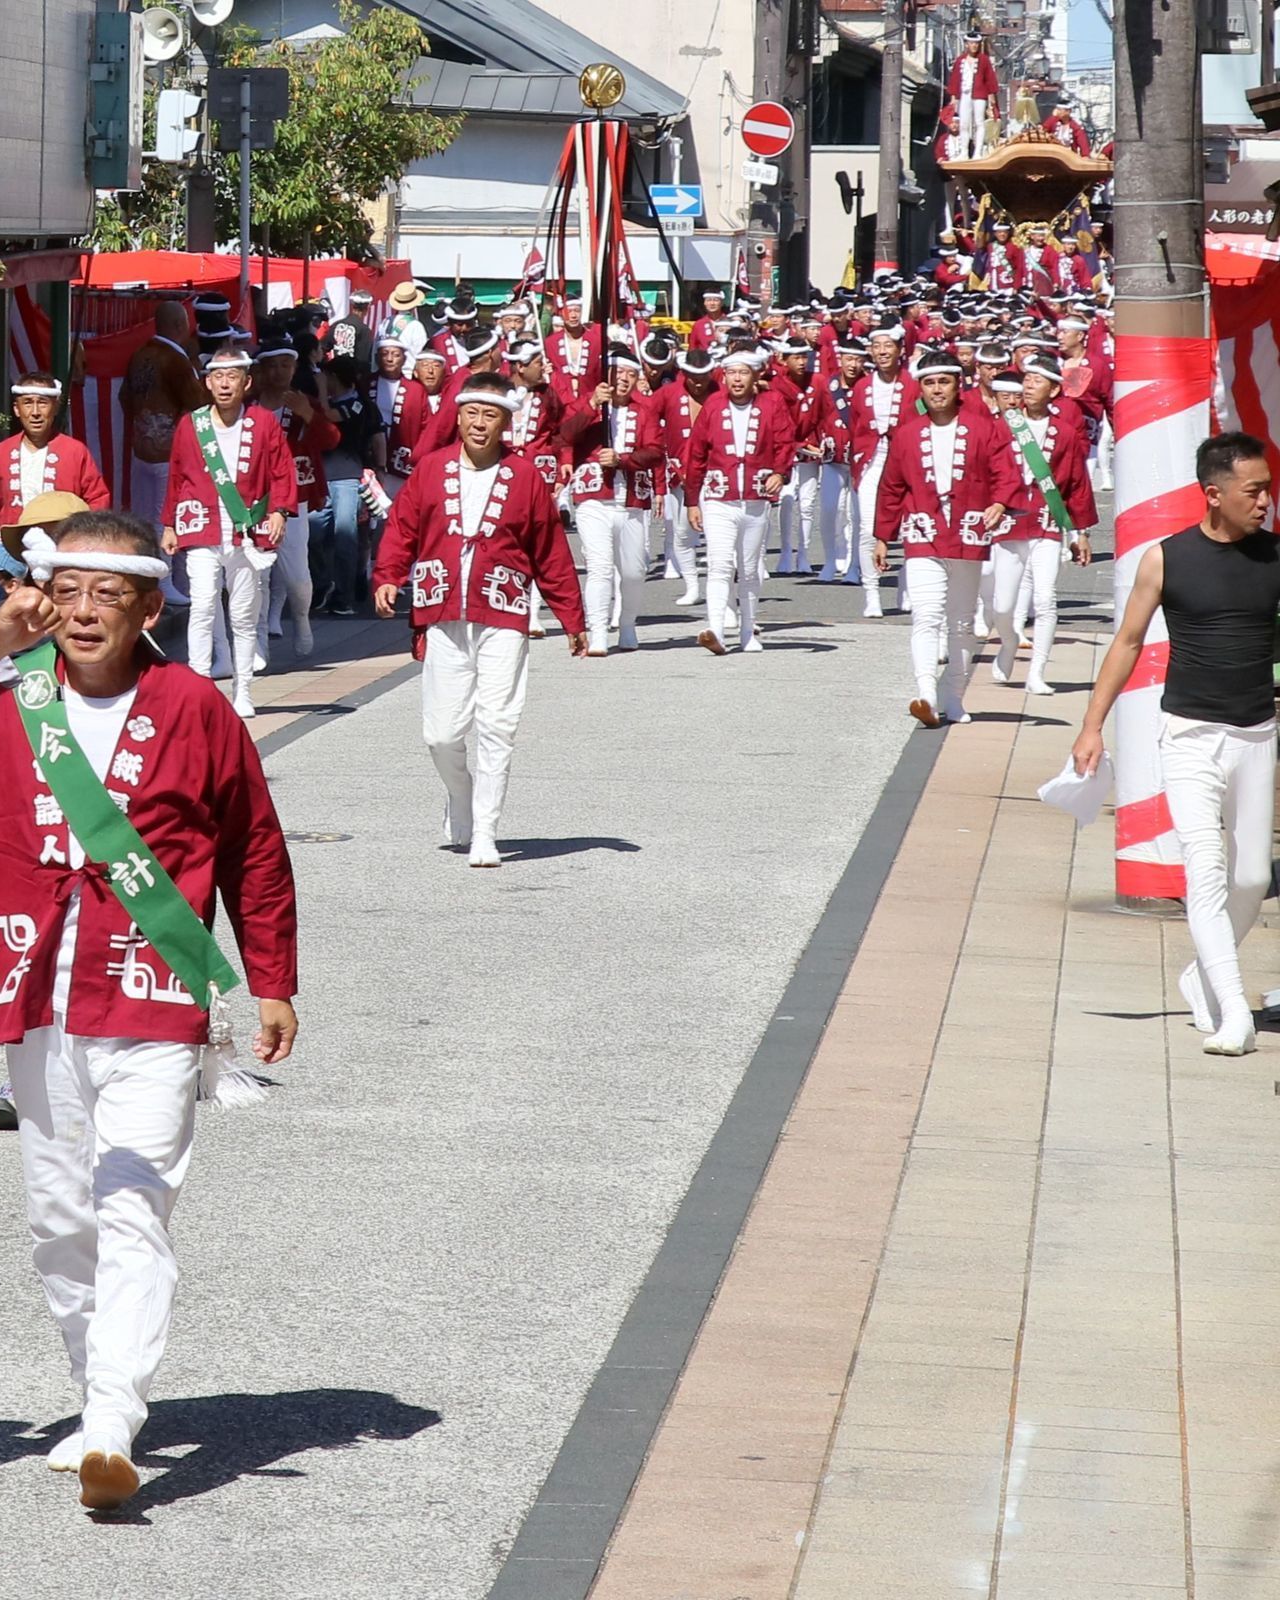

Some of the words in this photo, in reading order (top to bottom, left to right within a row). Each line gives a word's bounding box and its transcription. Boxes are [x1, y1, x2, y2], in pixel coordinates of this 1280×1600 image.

[443, 478, 462, 536] 世話人
[480, 482, 509, 538] 紙屋町
[32, 759, 66, 866] 話人
[39, 721, 156, 898] 会計
